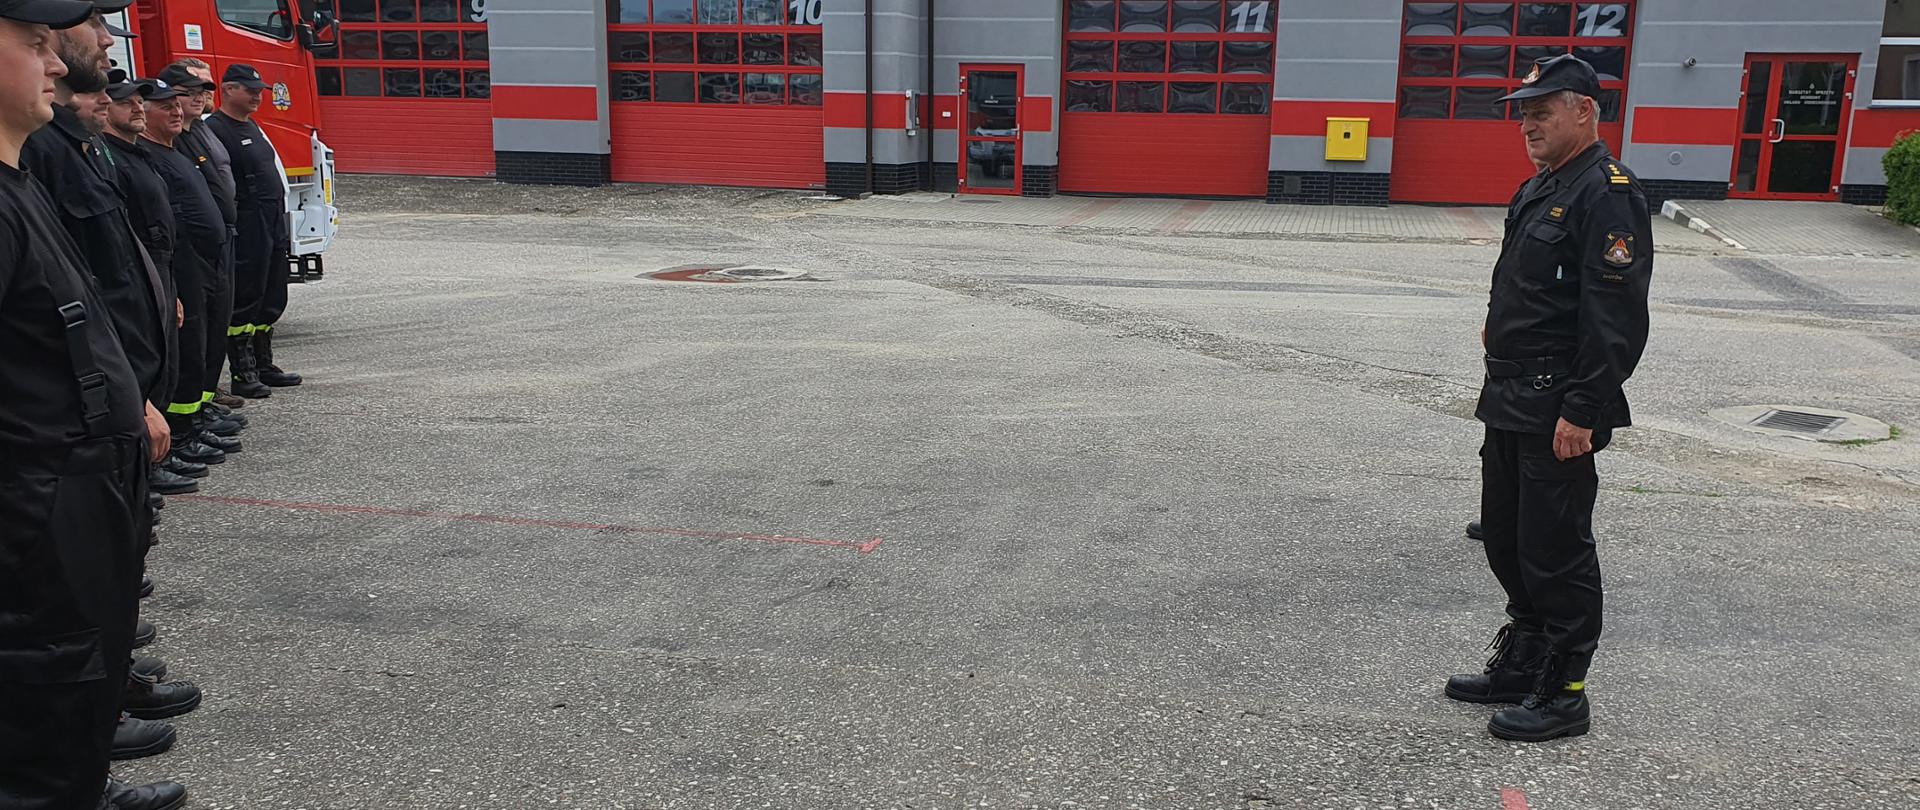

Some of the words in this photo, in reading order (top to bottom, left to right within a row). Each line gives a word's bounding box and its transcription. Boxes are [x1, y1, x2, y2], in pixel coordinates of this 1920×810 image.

[471, 0, 487, 22] 9
[790, 0, 823, 25] 10
[1231, 1, 1269, 32] 11
[1578, 4, 1626, 37] 12
